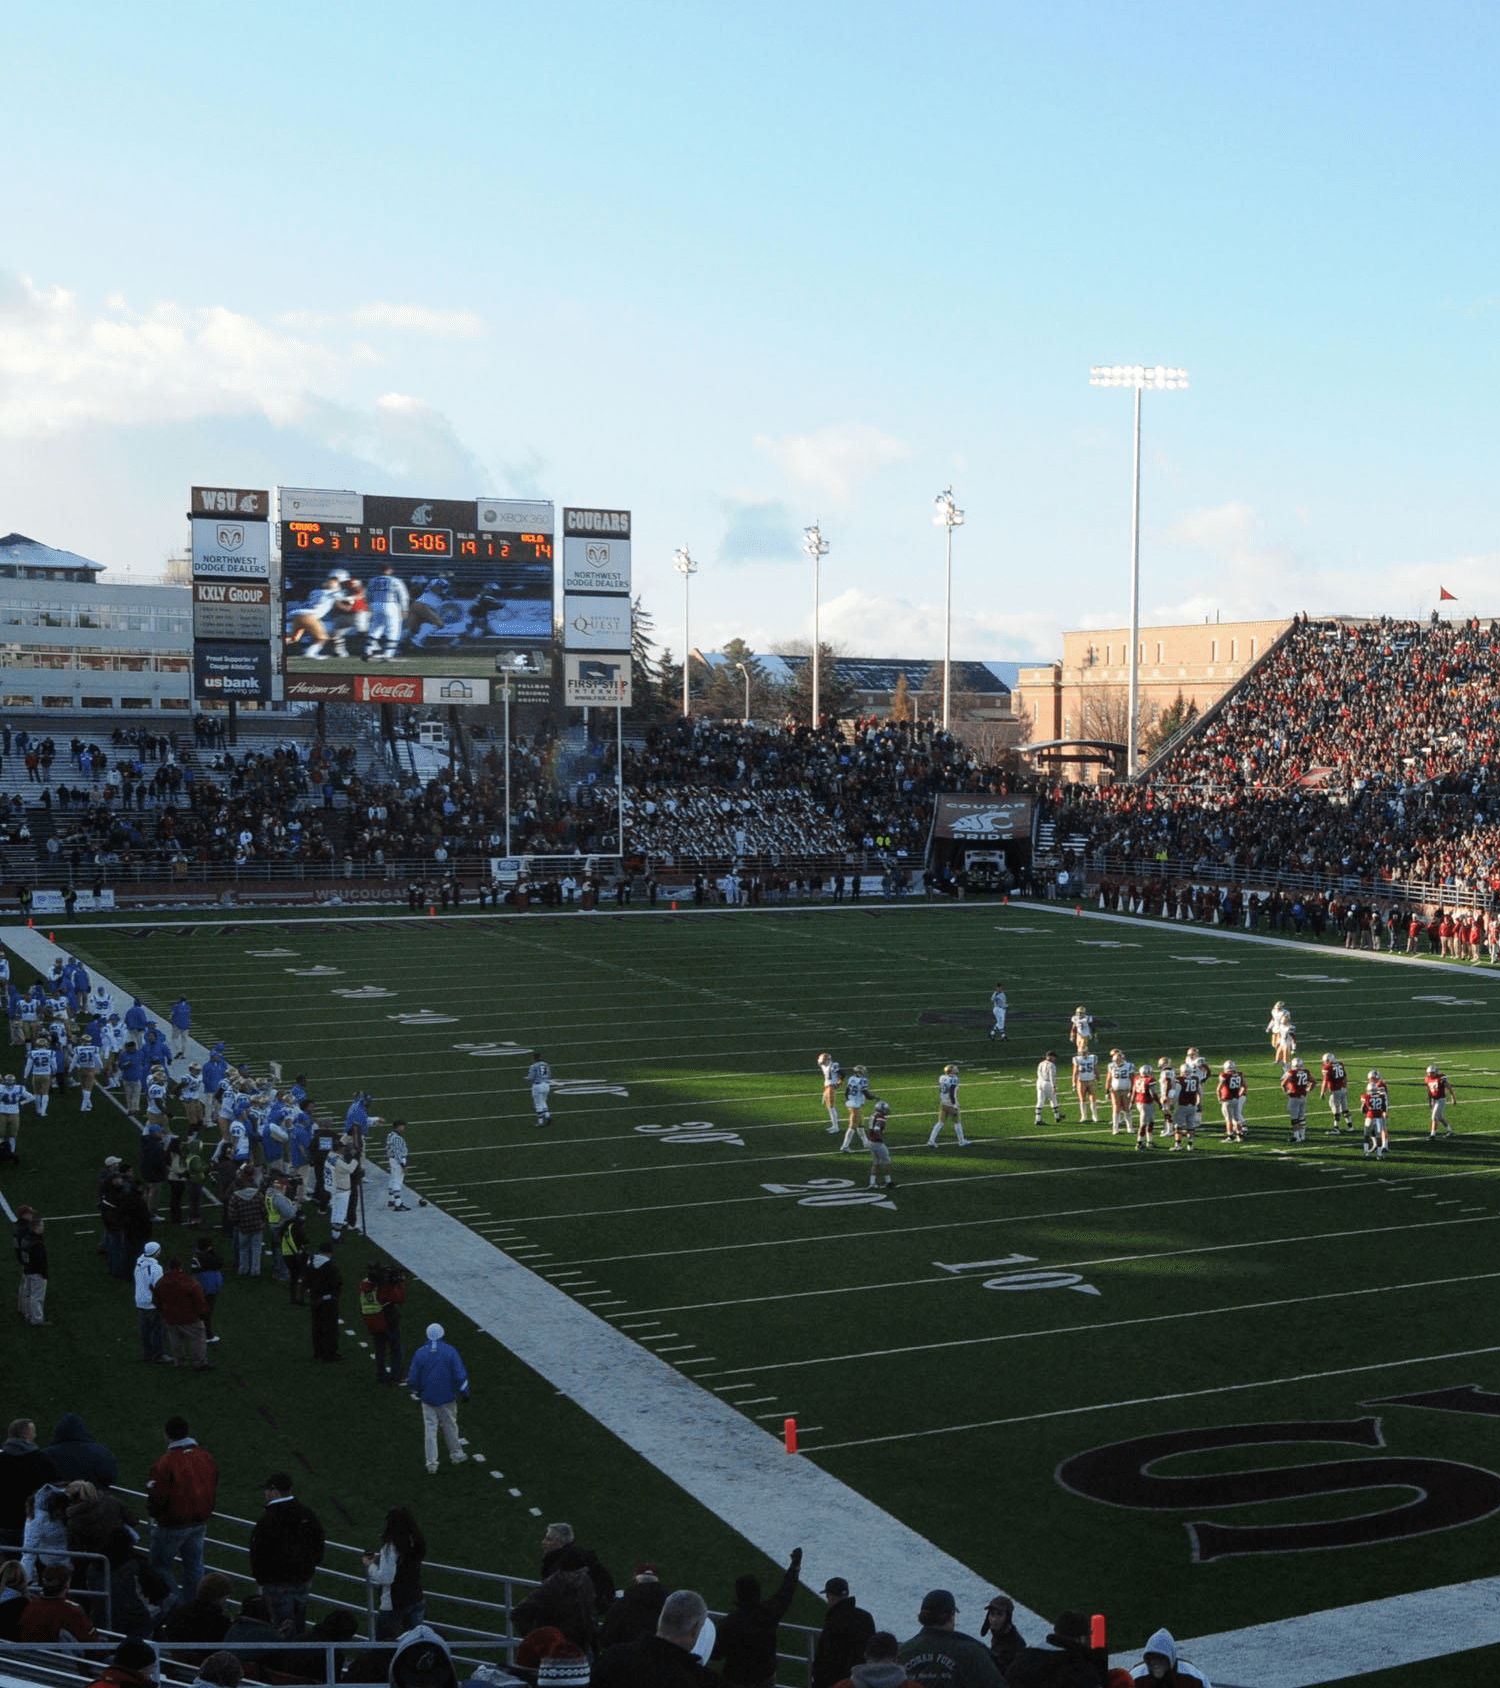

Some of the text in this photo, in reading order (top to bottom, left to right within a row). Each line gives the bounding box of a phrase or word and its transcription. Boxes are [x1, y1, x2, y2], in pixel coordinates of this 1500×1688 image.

[200, 490, 237, 511] WSU
[567, 511, 629, 532] COUGARS
[297, 532, 309, 548] 0
[331, 536, 340, 550] 3
[371, 536, 387, 552] 10
[408, 533, 447, 551] 5:06
[461, 540, 477, 555] 19
[500, 545, 510, 558] 2
[535, 544, 552, 559] 14
[203, 555, 258, 565] NORTHWEST
[194, 563, 267, 573] DODGE DEALERS
[574, 571, 622, 580] NORTHWEST
[567, 579, 629, 588] DODGE DEALERS
[198, 585, 226, 601] KXLY
[568, 679, 598, 688] FIRST
[1296, 1072, 1308, 1085] 72
[1332, 1065, 1344, 1079] 76
[1184, 1079, 1197, 1092] 78
[1229, 1077, 1242, 1089] 69
[1369, 1097, 1382, 1110] 32
[634, 1121, 741, 1145] 30
[760, 1178, 888, 1208] 20
[933, 1253, 1085, 1292] 10
